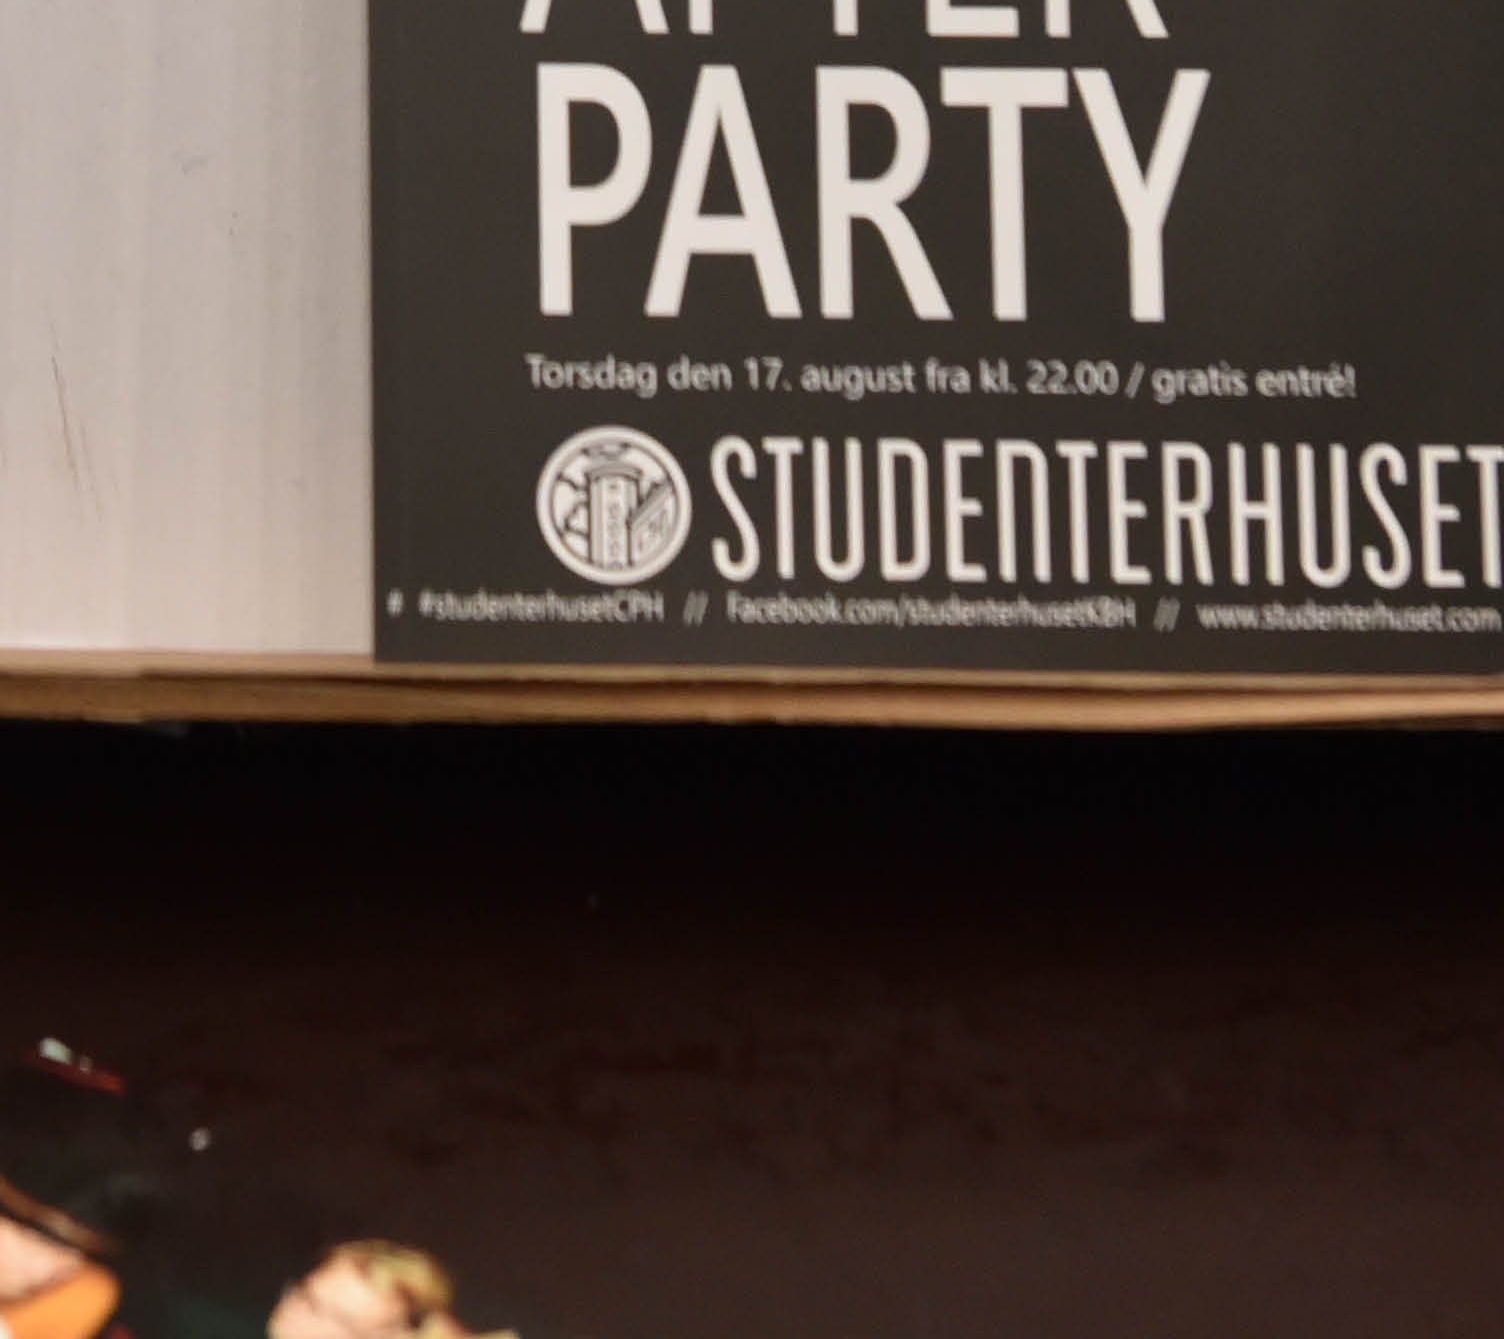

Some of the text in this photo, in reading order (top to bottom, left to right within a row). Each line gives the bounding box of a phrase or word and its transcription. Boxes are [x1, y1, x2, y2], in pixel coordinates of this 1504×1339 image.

[538, 64, 1209, 321] PARTY
[526, 354, 657, 398] Torsdag
[667, 356, 732, 390] den
[745, 357, 791, 390] 17.
[801, 362, 915, 400] august
[925, 358, 970, 393] fra
[980, 360, 1017, 392] kl.
[1027, 360, 1119, 395] 22.00
[1152, 366, 1248, 403] gratis
